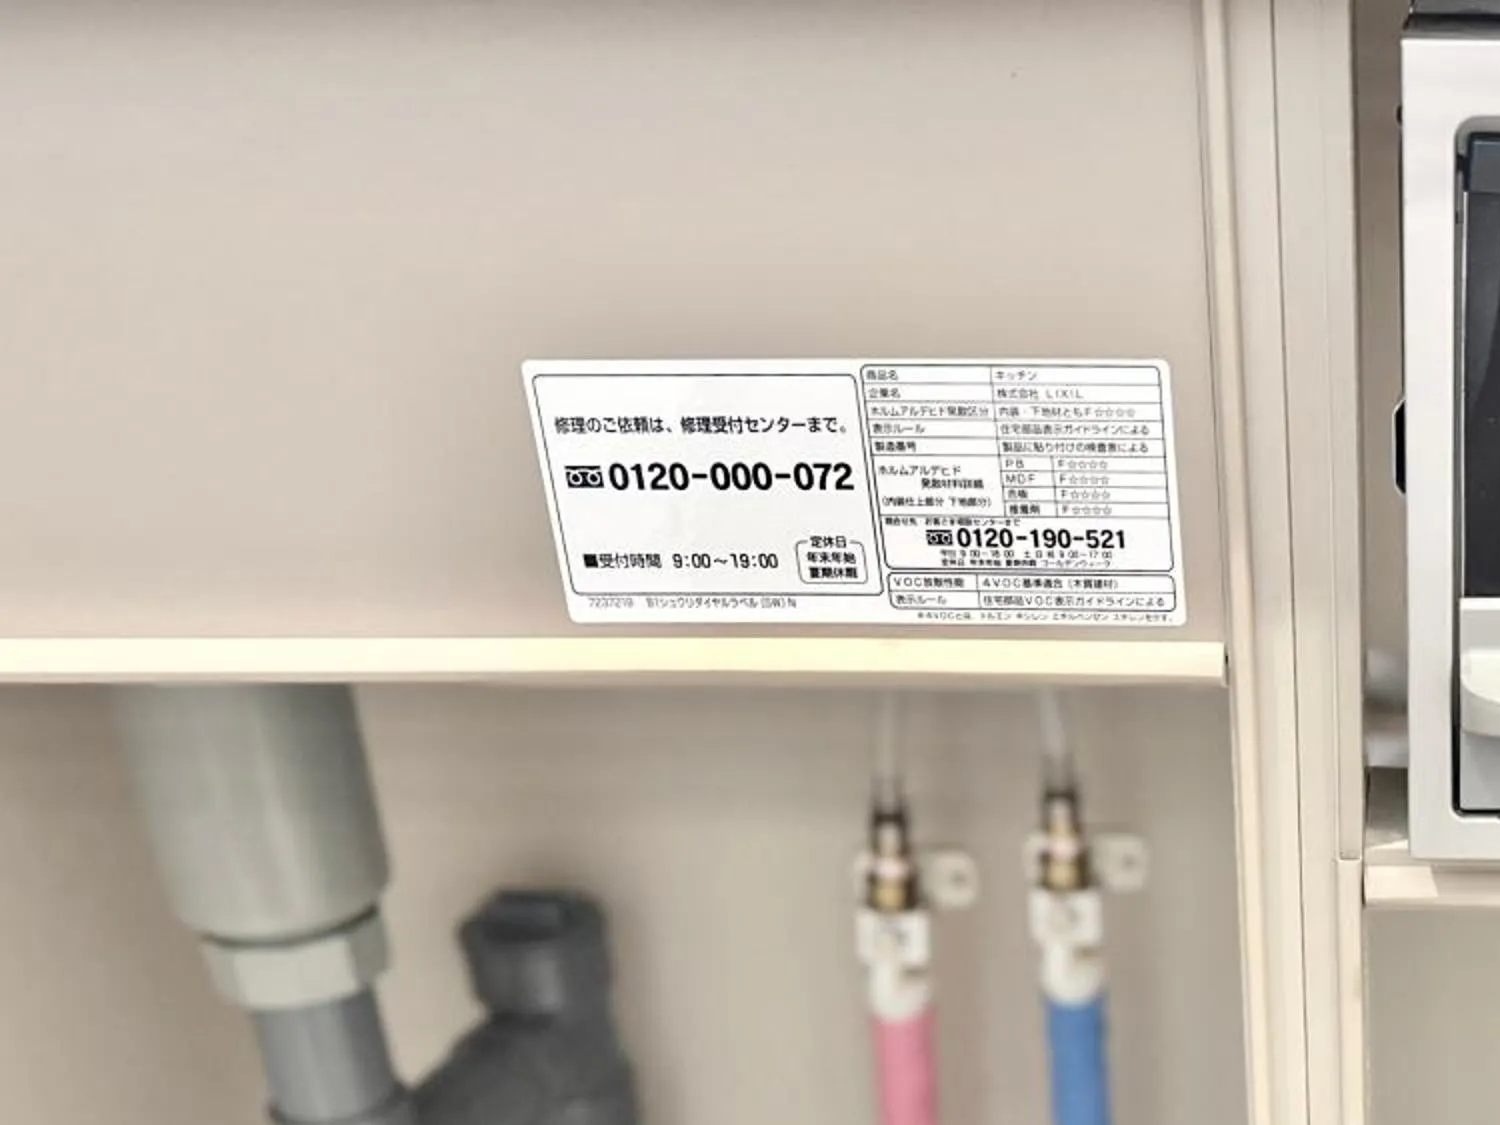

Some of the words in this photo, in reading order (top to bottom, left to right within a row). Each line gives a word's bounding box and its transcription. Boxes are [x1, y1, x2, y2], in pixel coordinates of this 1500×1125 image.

[995, 370, 1037, 381] キッチン
[1046, 390, 1083, 400] LIXIL
[554, 416, 848, 435] 修理のご依頼は、修理受付センターまで。
[609, 462, 855, 491] 0120-000-072
[810, 536, 847, 549] 定休日
[957, 528, 1125, 549] 0120-190-521
